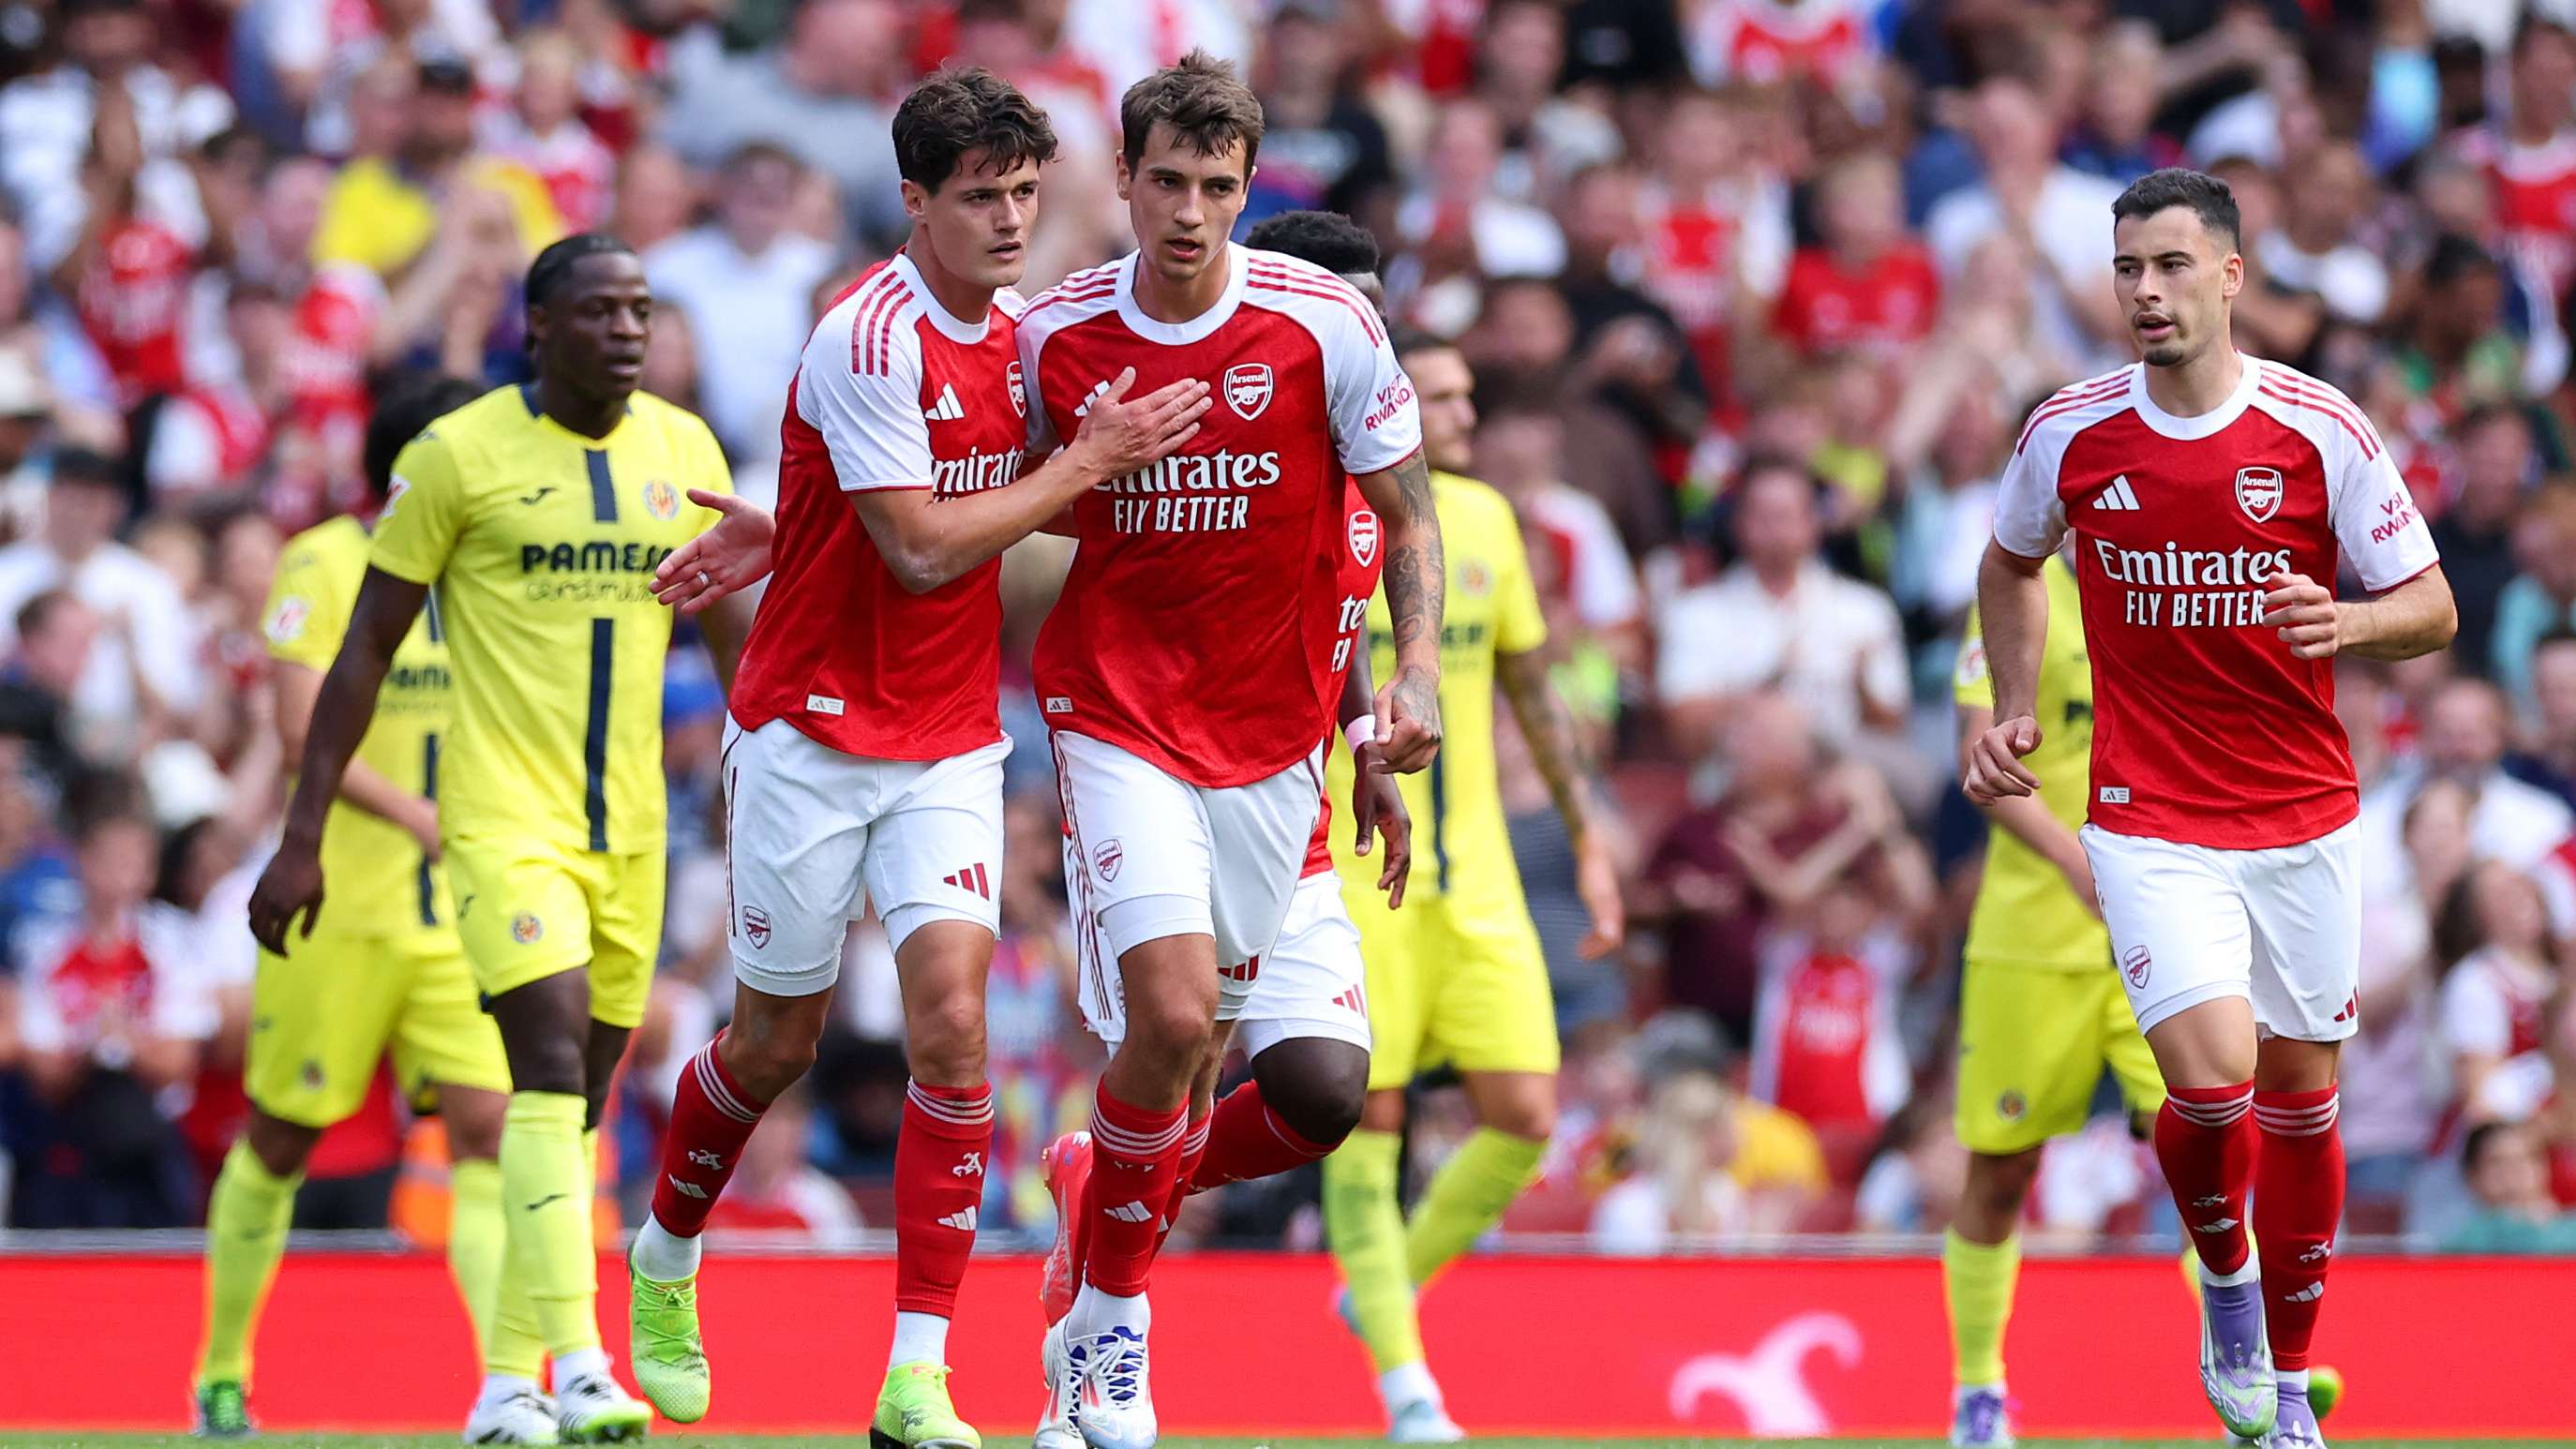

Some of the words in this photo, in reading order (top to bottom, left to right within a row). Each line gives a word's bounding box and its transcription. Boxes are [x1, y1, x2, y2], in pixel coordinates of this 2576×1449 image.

[1365, 381, 1414, 431] RWAND
[933, 444, 1025, 493] mirate
[1093, 447, 1281, 494] irates
[1114, 500, 1150, 533] FLY
[1155, 496, 1249, 532] BETTER
[2094, 538, 2291, 586] Emirates
[2126, 590, 2162, 626] FLY
[2172, 590, 2266, 627] BETTER
